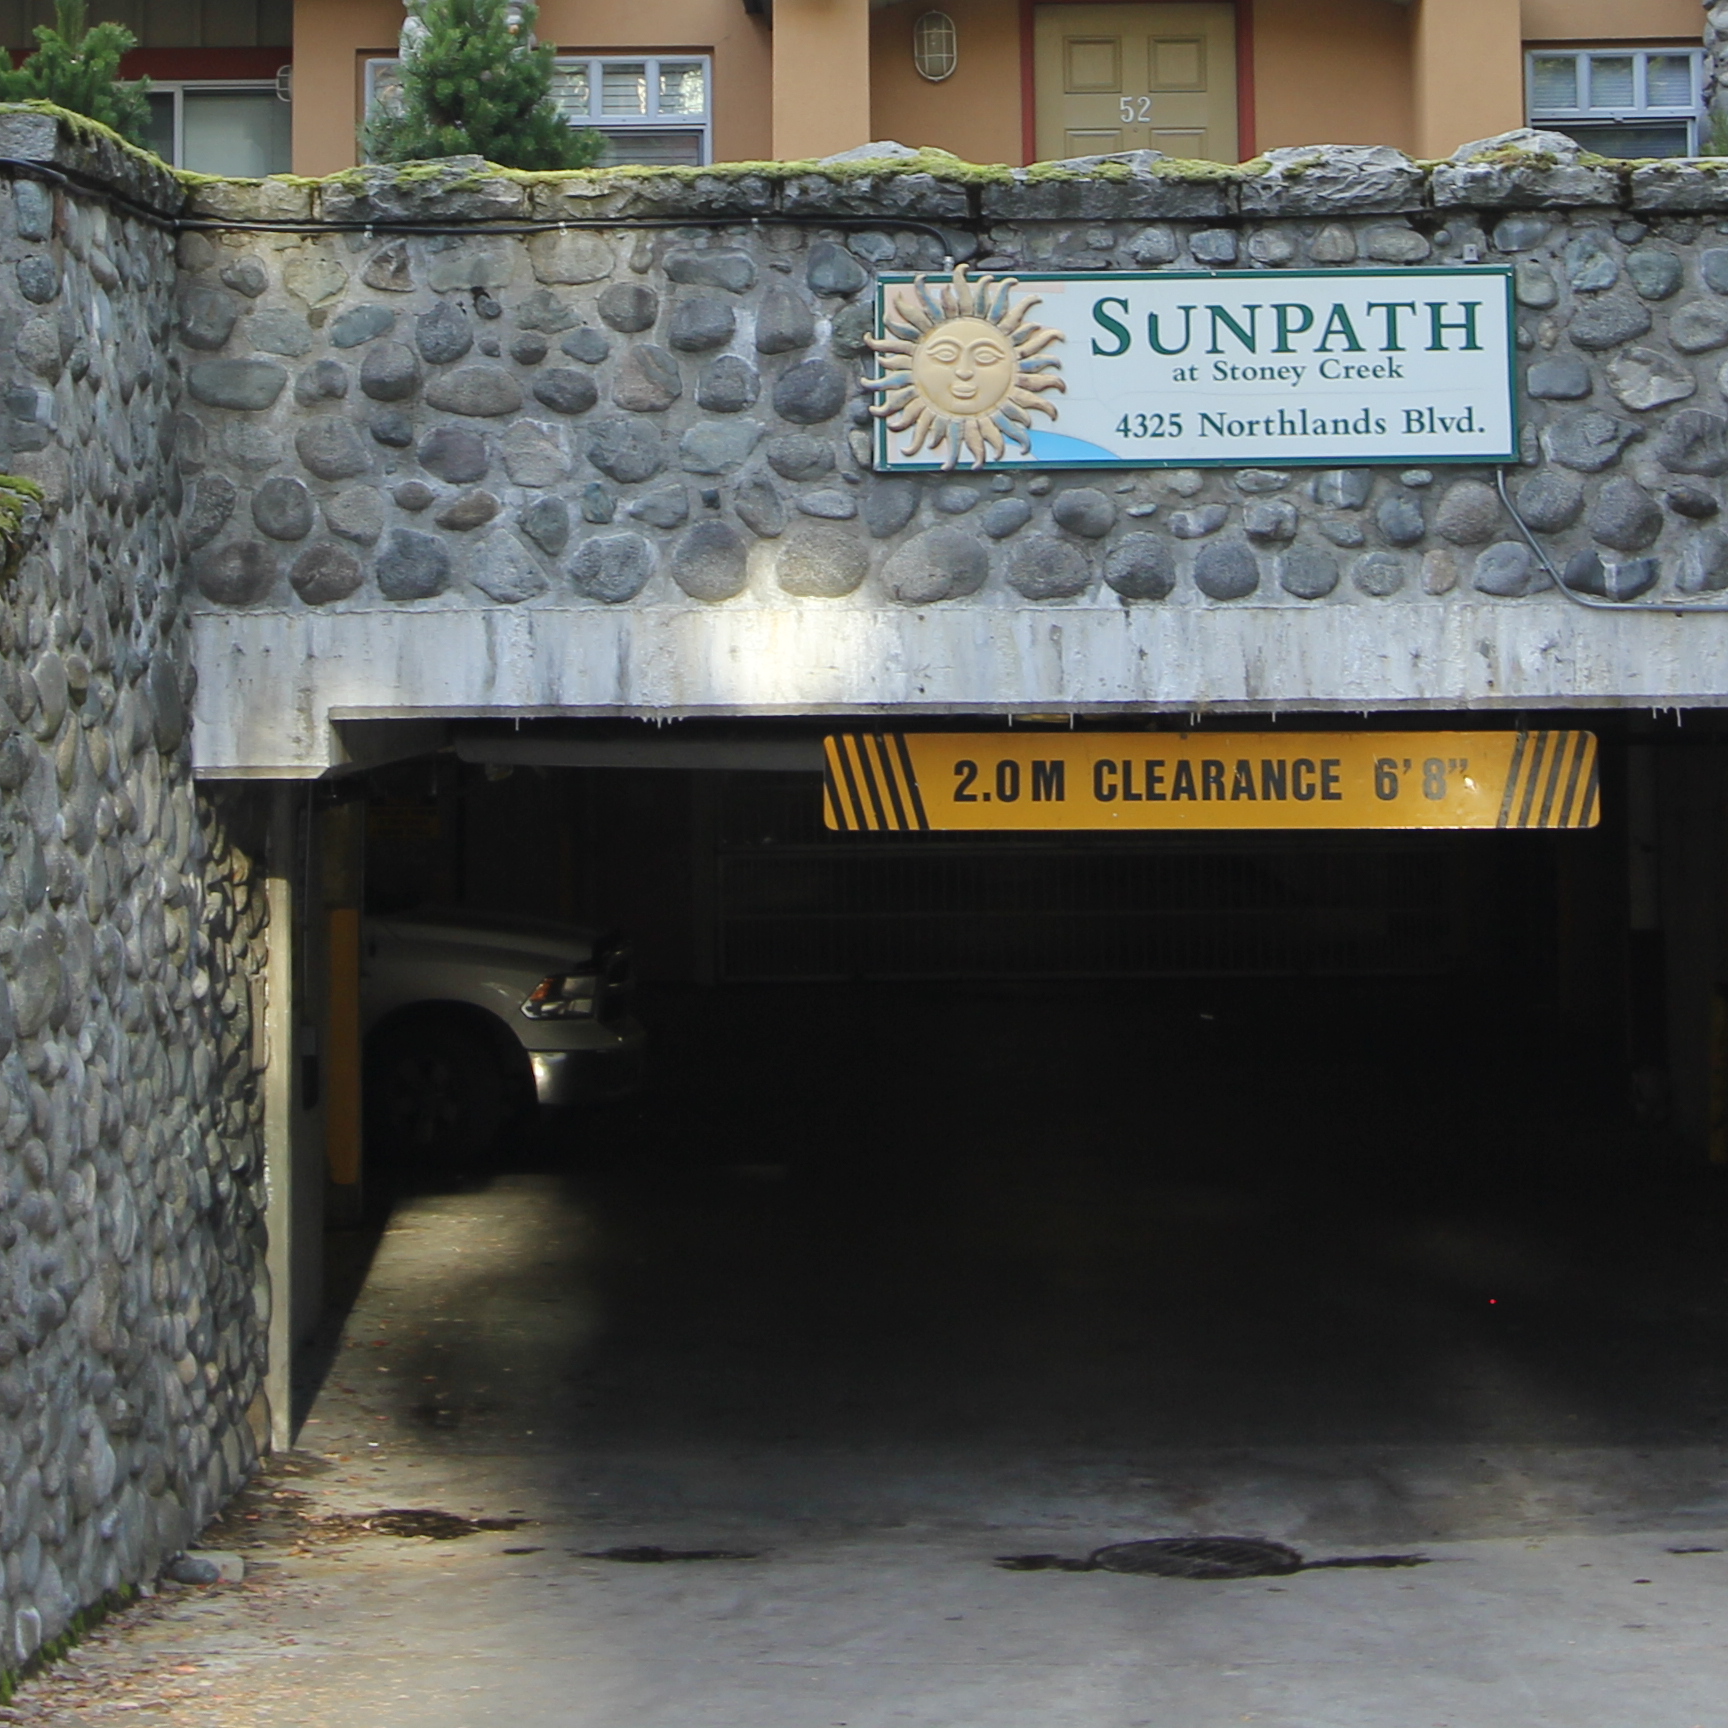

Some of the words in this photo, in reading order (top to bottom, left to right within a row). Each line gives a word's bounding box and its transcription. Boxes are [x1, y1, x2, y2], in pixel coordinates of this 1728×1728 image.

[1119, 96, 1152, 123] 52
[1090, 296, 1485, 357] SUNPATH
[1172, 361, 1201, 383] at
[1211, 358, 1307, 387] Stoney
[1318, 355, 1405, 381] Creek
[1115, 412, 1184, 440] 4325
[1197, 407, 1387, 438] Northlands
[1401, 407, 1486, 435] Blvd.
[1092, 757, 1342, 802] CLEARANCE
